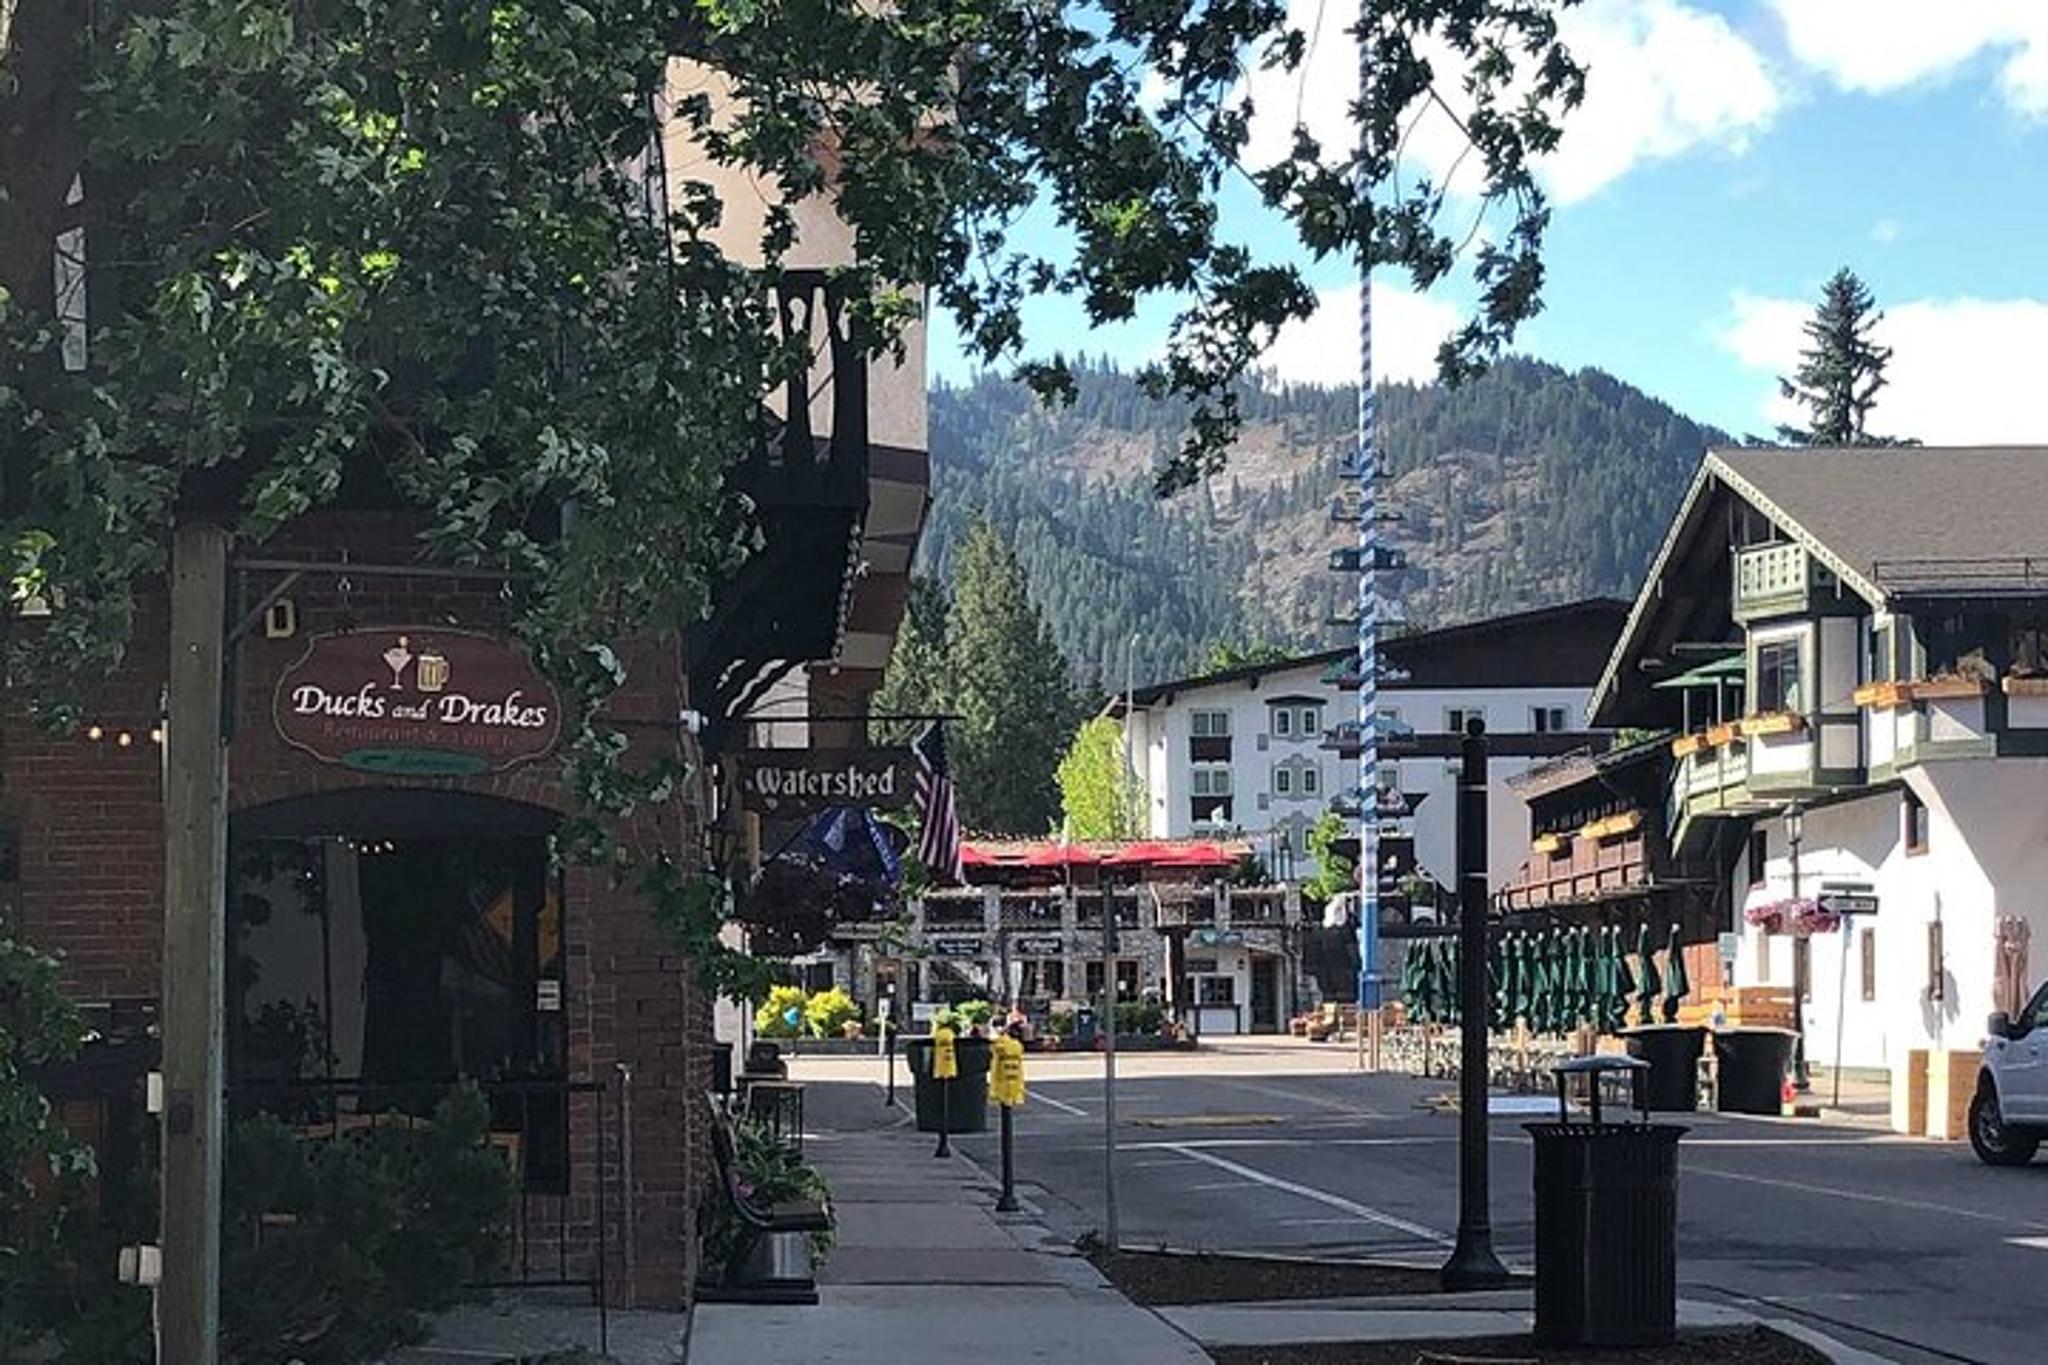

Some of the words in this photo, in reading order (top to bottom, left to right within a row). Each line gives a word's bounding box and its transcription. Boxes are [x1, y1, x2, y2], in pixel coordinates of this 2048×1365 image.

[292, 682, 386, 718] Ducks
[392, 699, 432, 720] and
[438, 691, 548, 727] Drakes
[755, 764, 895, 798] Watershed
